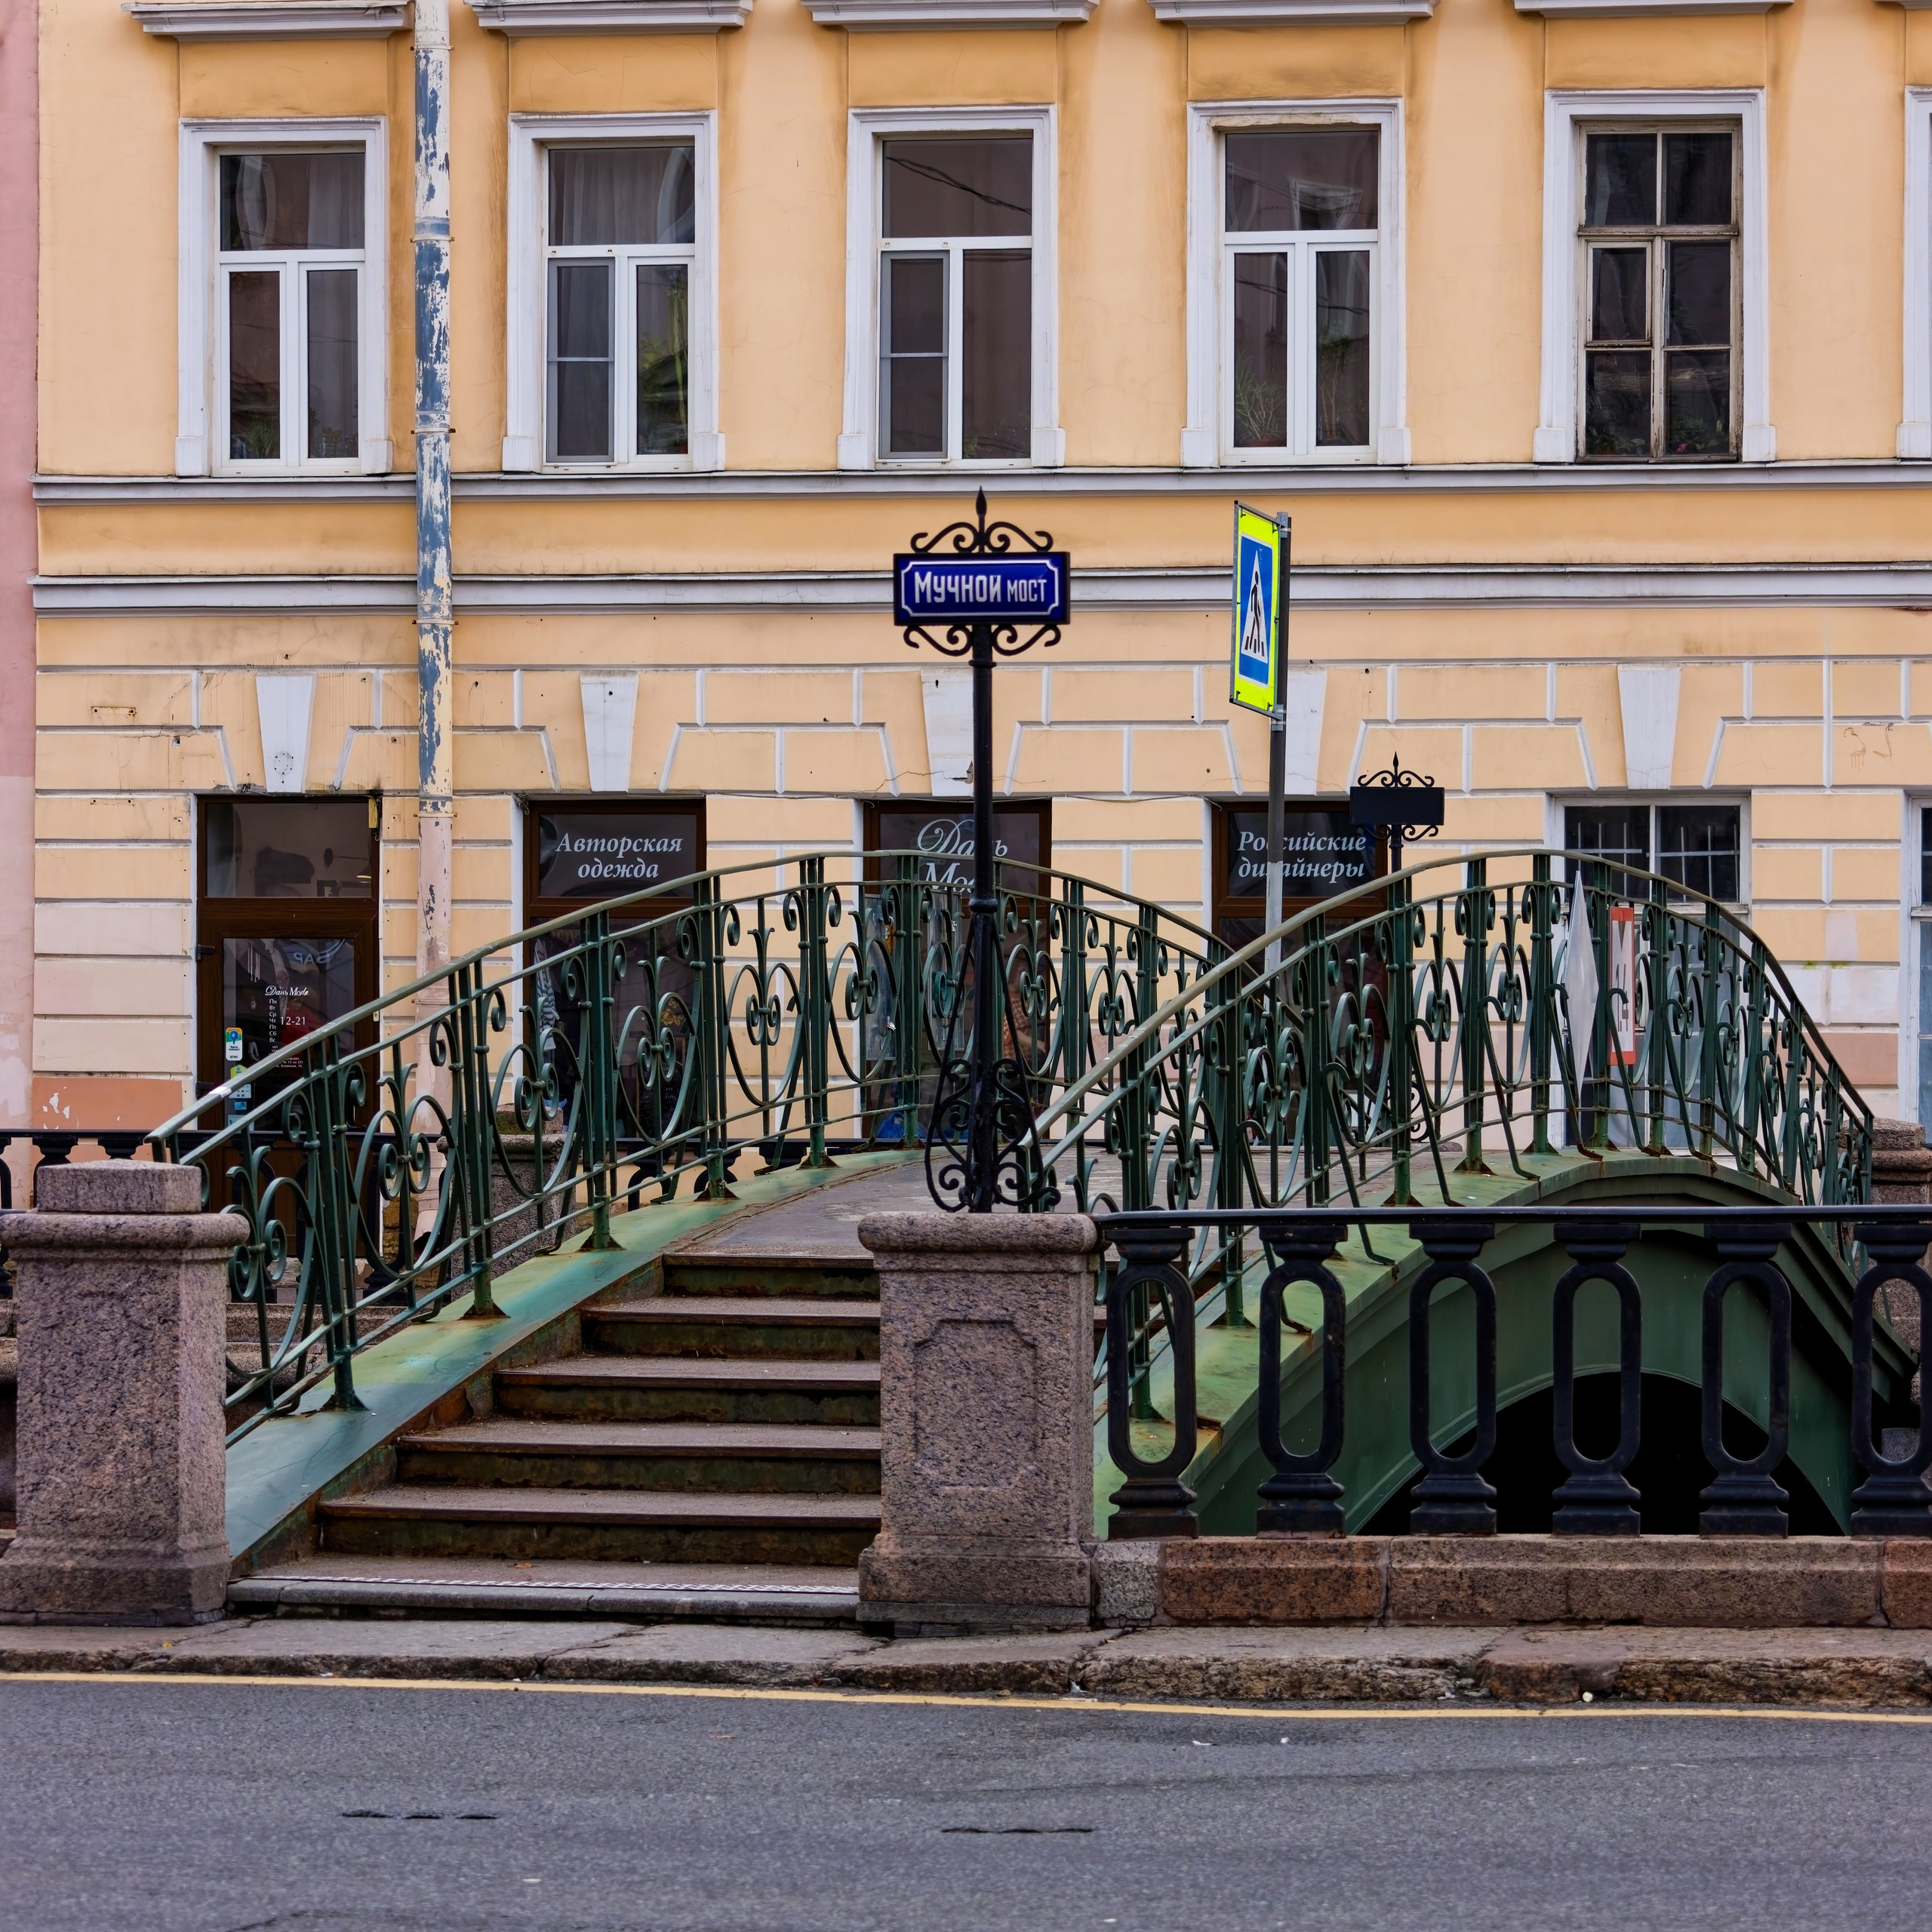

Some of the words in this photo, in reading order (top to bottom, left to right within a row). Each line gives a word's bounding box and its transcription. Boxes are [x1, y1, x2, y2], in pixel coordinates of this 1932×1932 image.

[914, 571, 1001, 603] Мучной
[1007, 579, 1048, 602] мост
[555, 832, 683, 858] Авторская
[917, 818, 1008, 857] Даь
[577, 857, 659, 878] одежда
[1238, 857, 1364, 884] диайнеры
[265, 985, 288, 996] Дань
[280, 1016, 306, 1026] 12-21
